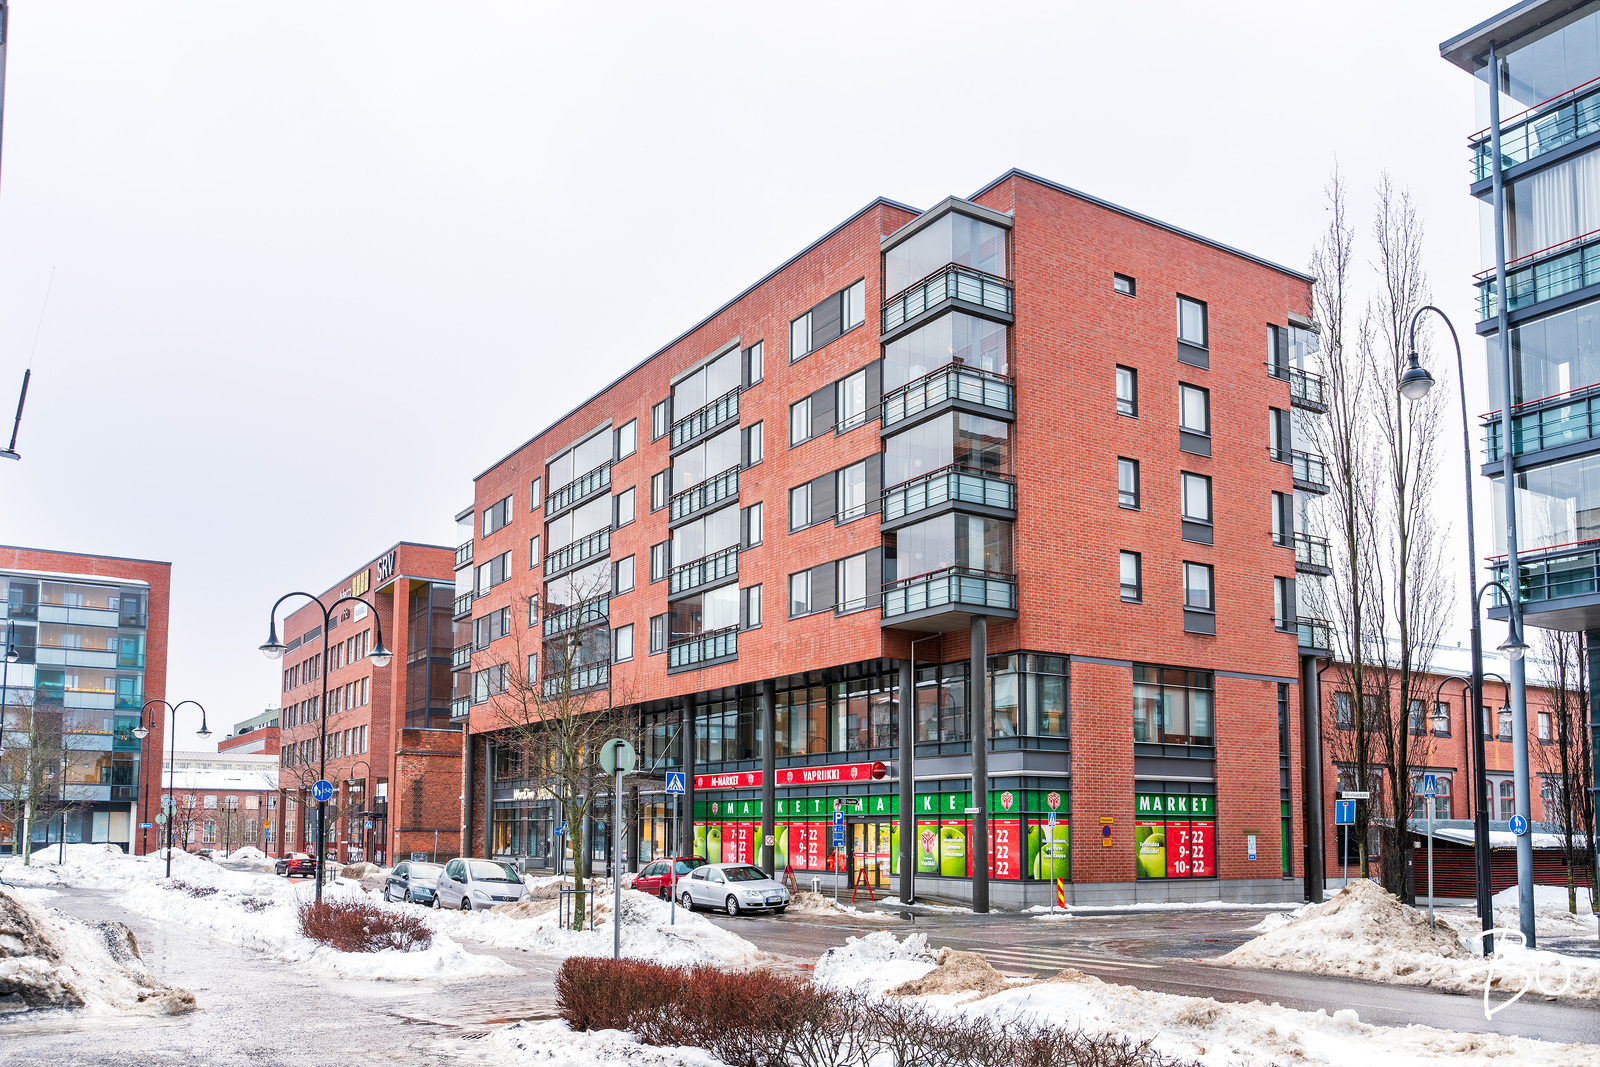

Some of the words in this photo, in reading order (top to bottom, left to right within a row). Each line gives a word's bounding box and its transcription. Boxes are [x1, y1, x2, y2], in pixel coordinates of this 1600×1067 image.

[377, 550, 396, 581] SRV
[711, 775, 739, 786] M-MARKET
[803, 769, 840, 781] VAPRIIKKI
[727, 800, 820, 814] MAKET
[1139, 796, 1207, 811] MARKET
[835, 812, 843, 824] P
